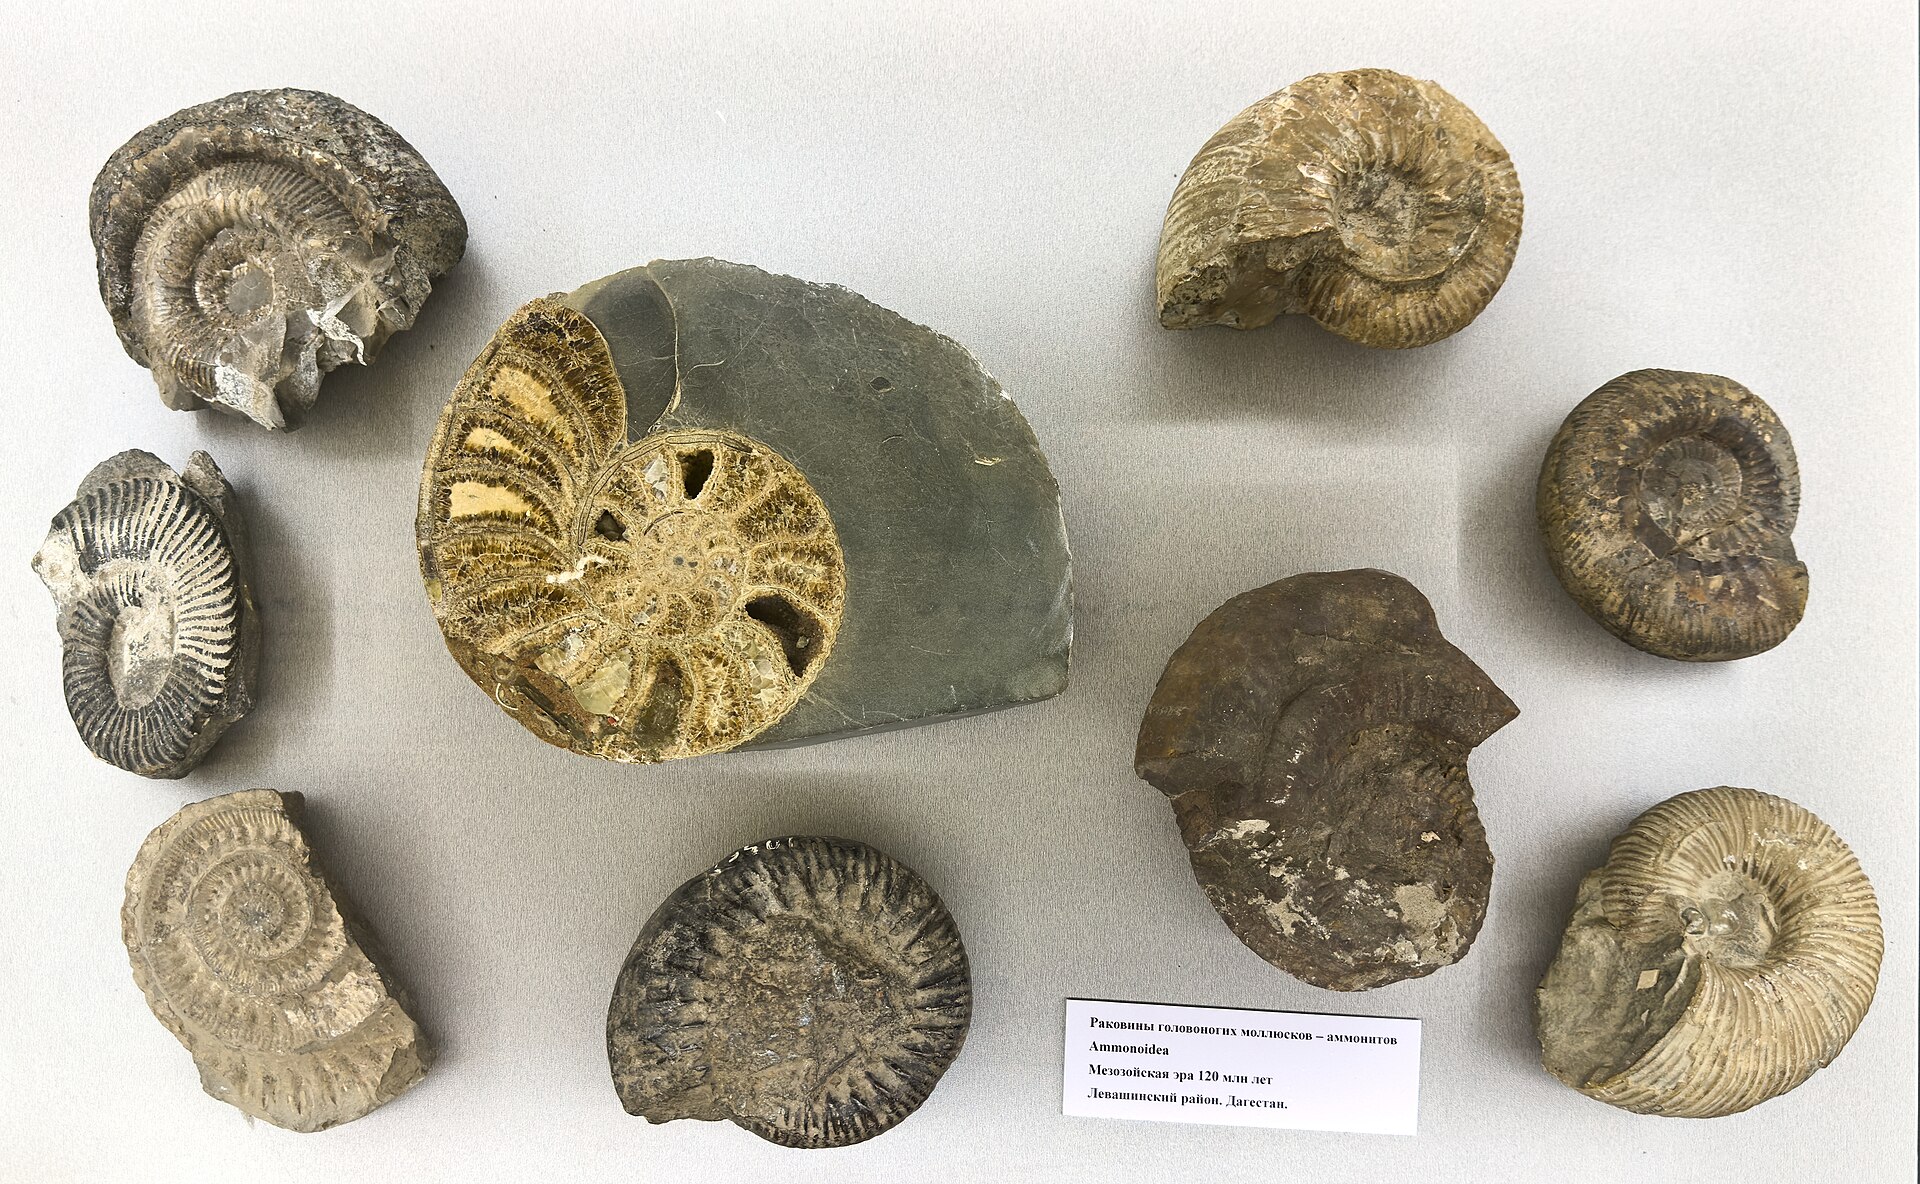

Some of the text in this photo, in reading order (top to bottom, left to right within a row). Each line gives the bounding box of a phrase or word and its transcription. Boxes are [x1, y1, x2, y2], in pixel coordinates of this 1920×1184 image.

[1090, 1016, 1155, 1032] Раковины
[1158, 1023, 1237, 1036] головоногих
[1241, 1028, 1313, 1041] моллюсков
[1326, 1033, 1398, 1045] аммонитов
[1089, 1040, 1169, 1056] Ammonoidea
[1089, 1063, 1273, 1085] Мезозойская эра 120 млн лет
[1087, 1087, 1288, 1109] Левашинский район. Дагестан.
